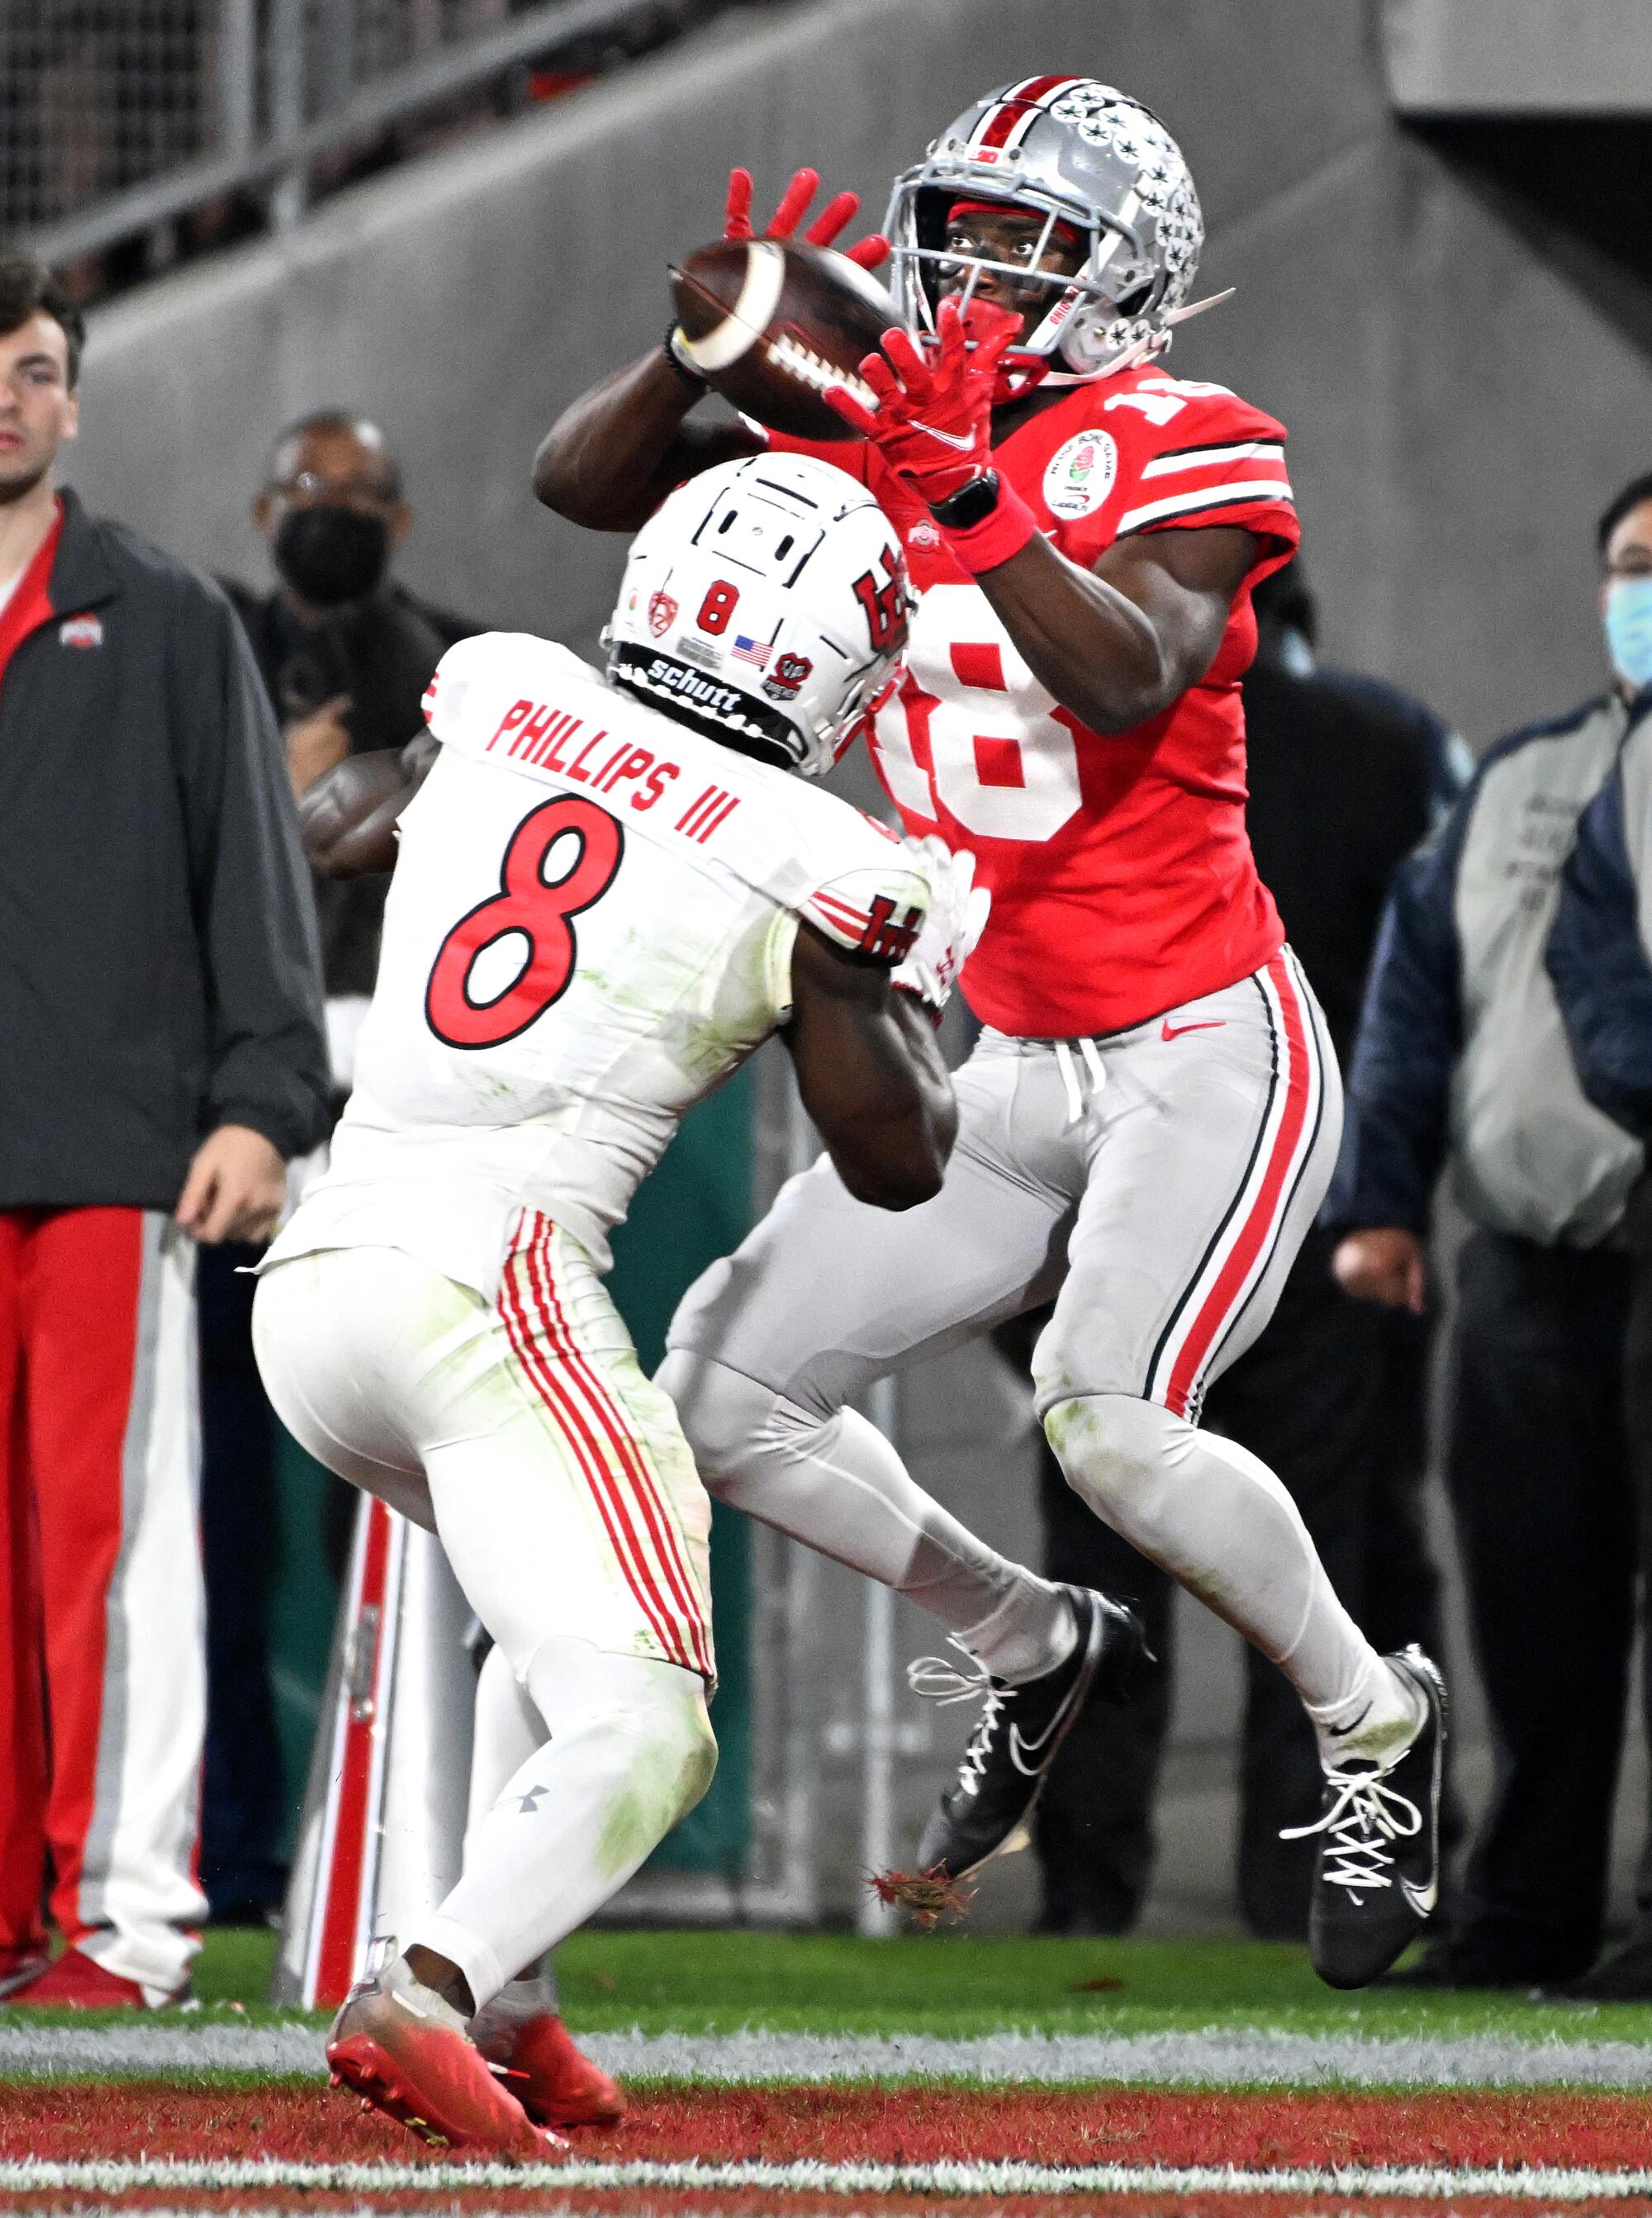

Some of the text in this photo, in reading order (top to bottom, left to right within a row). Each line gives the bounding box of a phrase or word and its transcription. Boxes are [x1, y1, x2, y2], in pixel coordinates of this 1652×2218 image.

[696, 579, 741, 636] 8
[648, 659, 742, 712] schutt
[486, 699, 742, 844] PHILLIPS III
[424, 791, 625, 1052] 8
